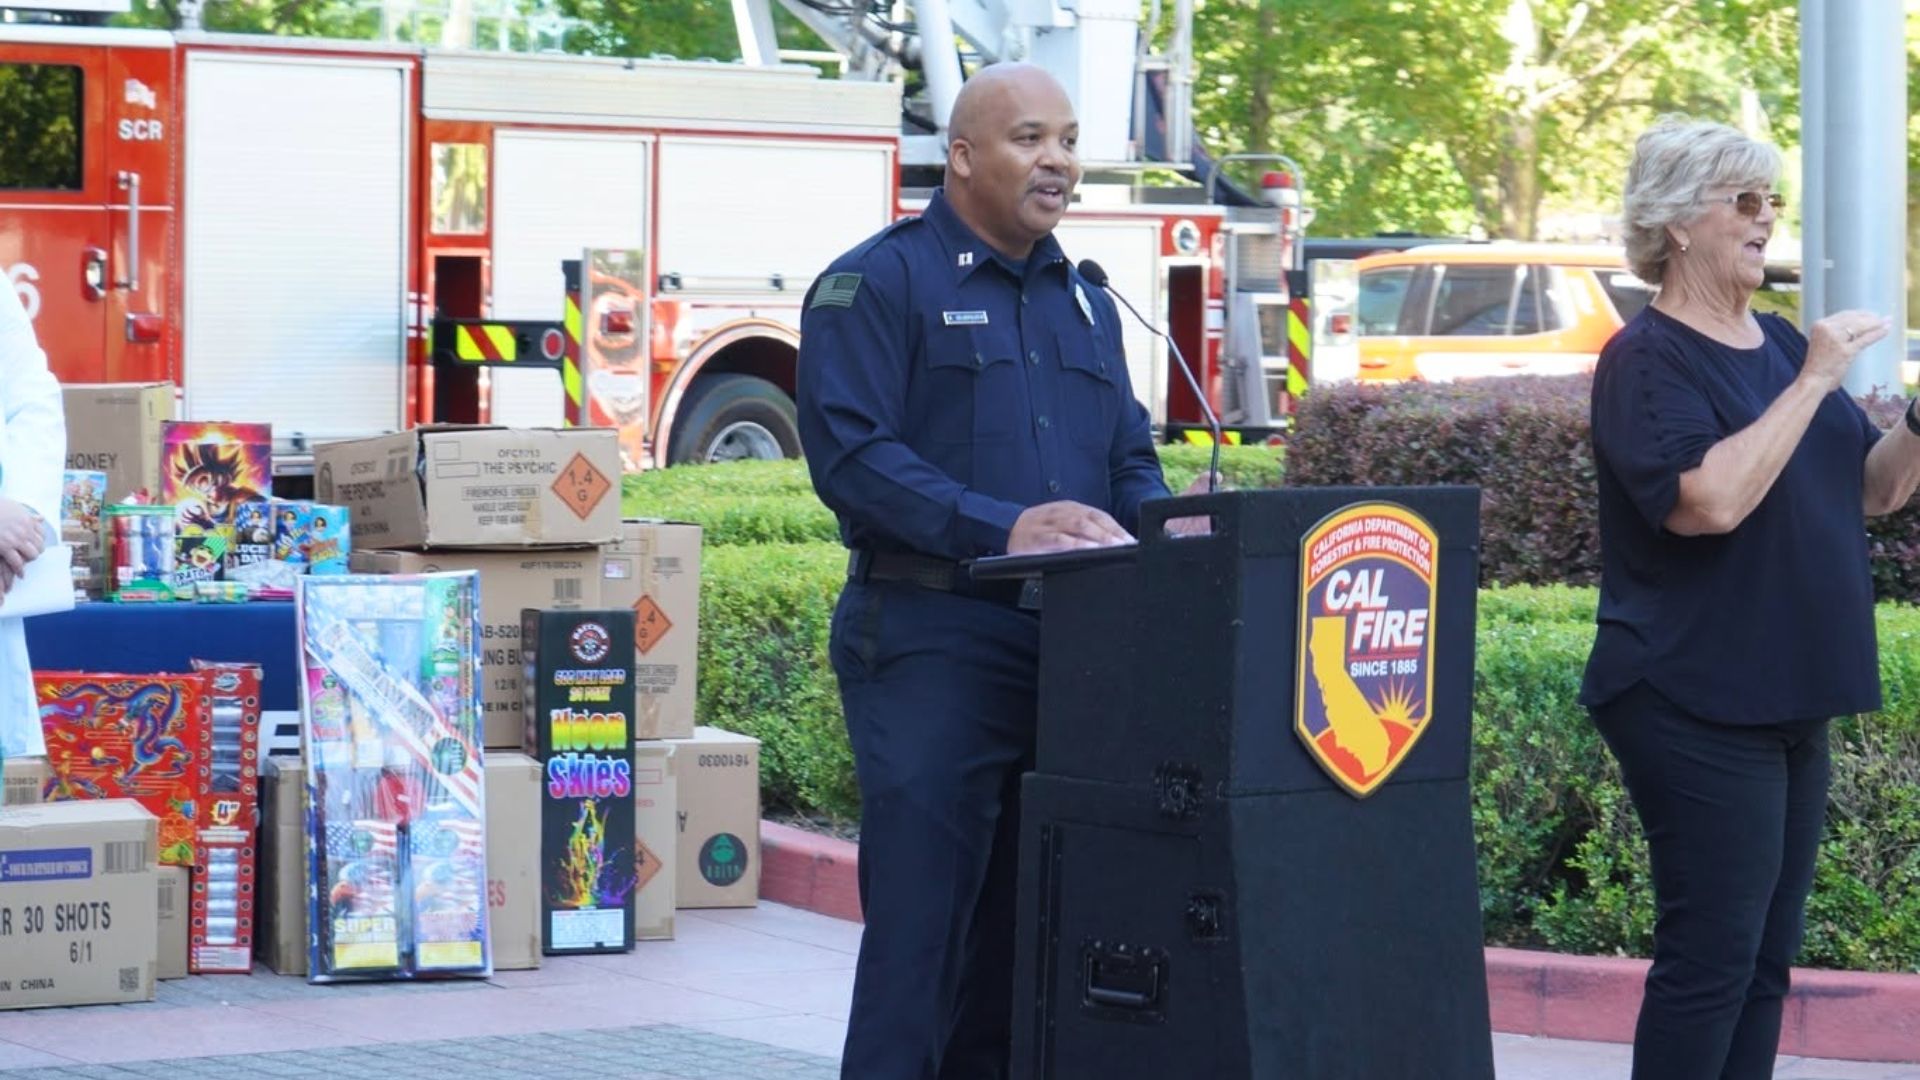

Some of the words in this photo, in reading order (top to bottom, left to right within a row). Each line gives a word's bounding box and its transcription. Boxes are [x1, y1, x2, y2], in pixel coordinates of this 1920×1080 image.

[118, 119, 163, 140] SCR
[483, 462, 505, 474] THE
[508, 462, 557, 474] PSYCHIC
[568, 469, 593, 486] 1.4
[576, 489, 587, 501] G
[1313, 519, 1364, 559] CALIFORNIA
[1365, 518, 1419, 543] DEPARTMENT
[1419, 539, 1430, 554] OF
[1311, 540, 1354, 579] FORESTRY
[1362, 536, 1381, 550] FIRE
[1382, 537, 1431, 575] PROTECTION
[1325, 568, 1389, 610] CAL
[1352, 608, 1429, 650] FIRE
[1350, 660, 1388, 677] SINCE
[1391, 659, 1418, 674] 1885
[547, 752, 631, 799] Skies
[24, 905, 45, 934] 30
[55, 901, 112, 932] SHOTS
[69, 941, 93, 964] 6/1
[20, 977, 55, 990] CHINA
